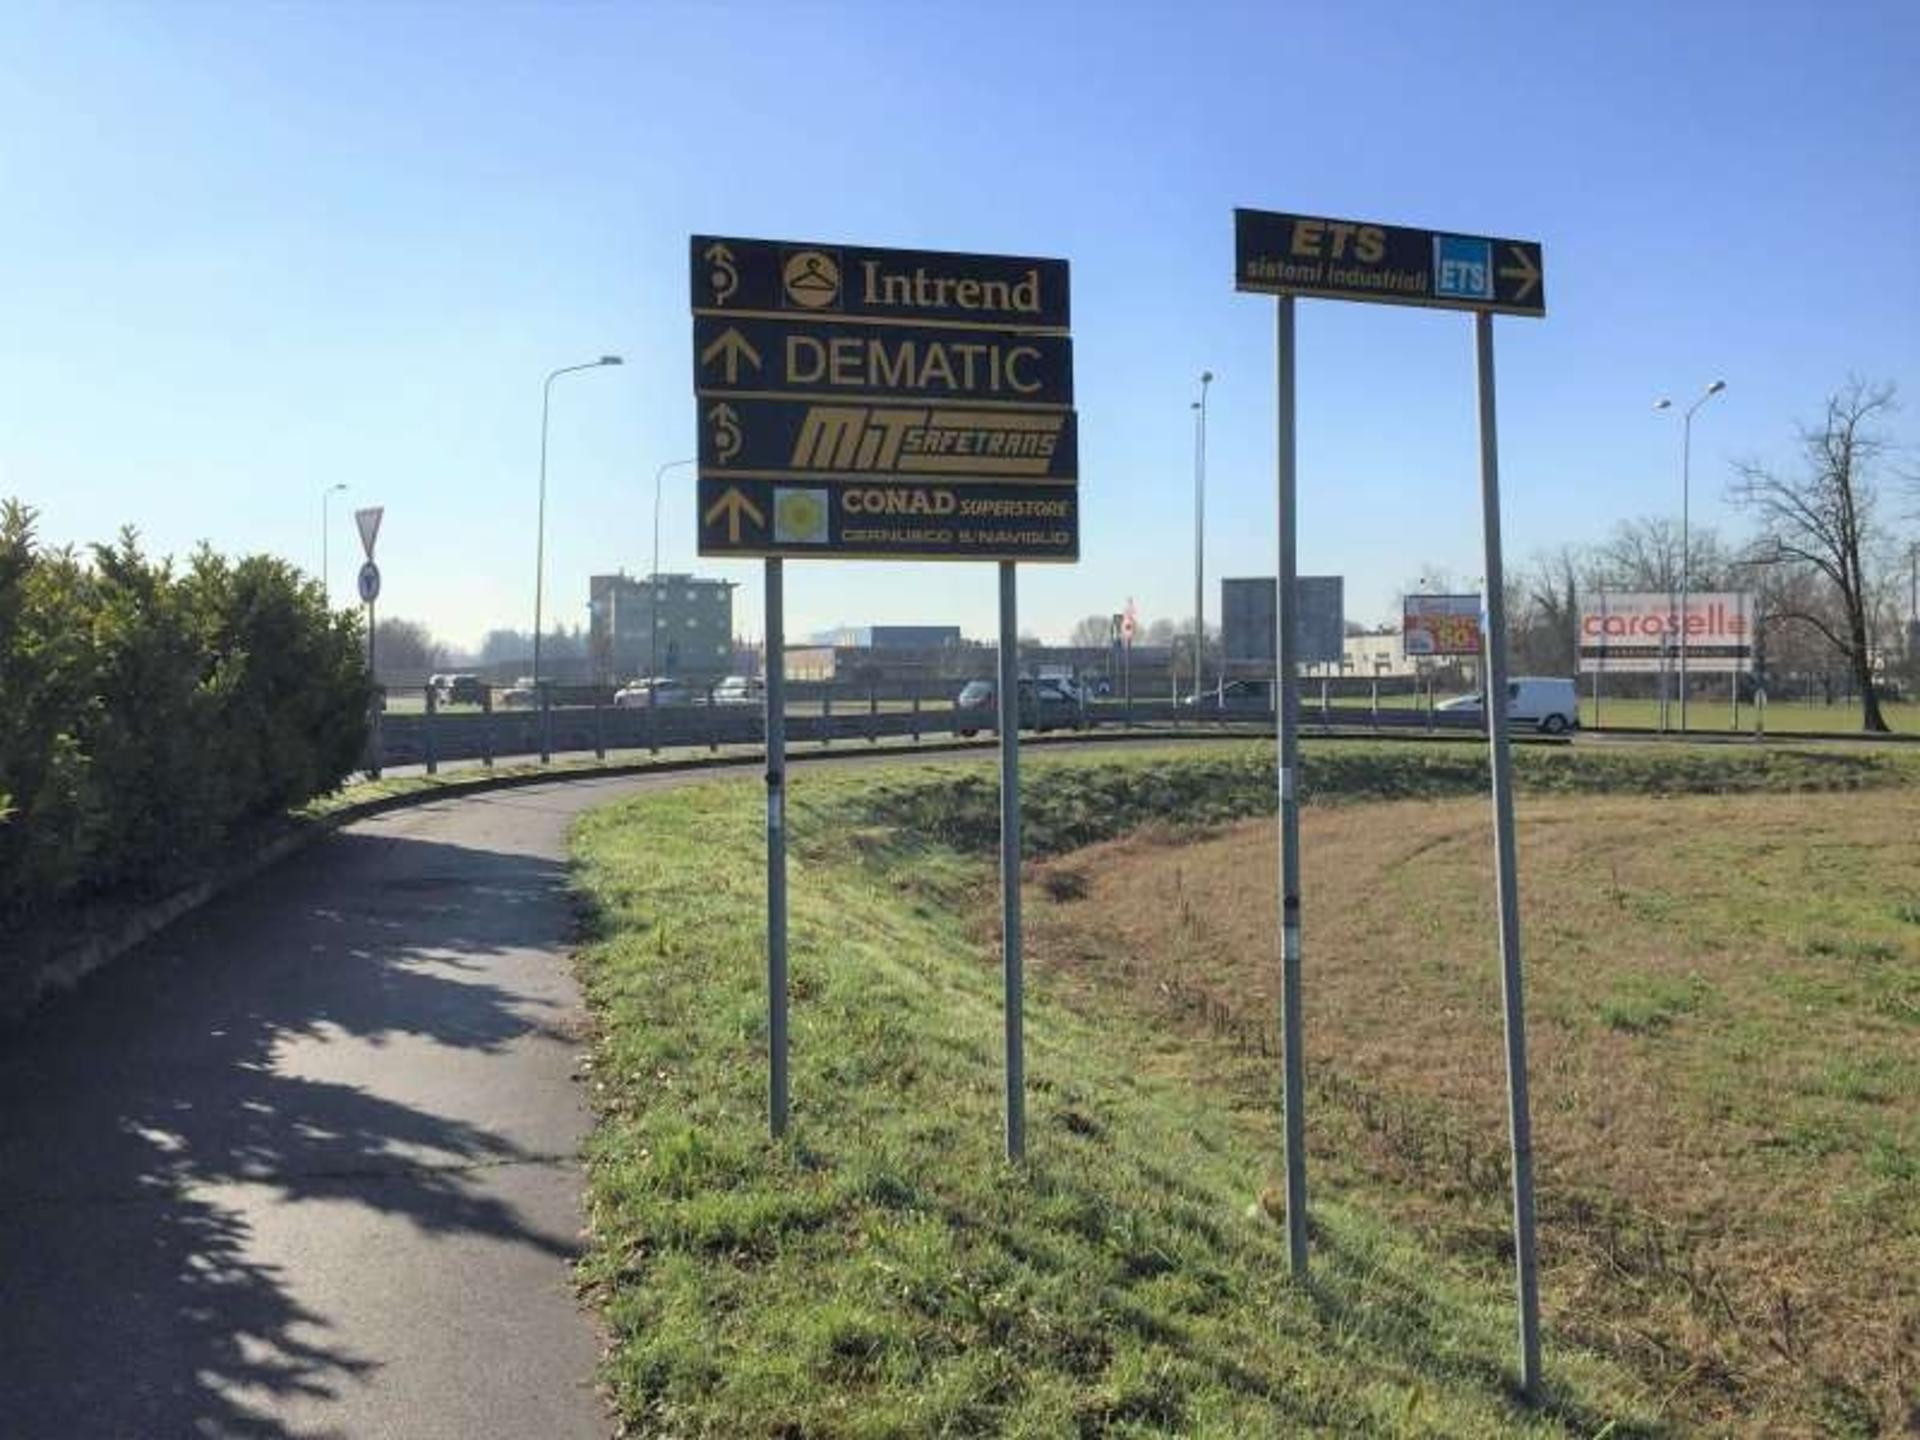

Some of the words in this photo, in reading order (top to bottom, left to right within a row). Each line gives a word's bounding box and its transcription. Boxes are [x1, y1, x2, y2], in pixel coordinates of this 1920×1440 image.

[1292, 220, 1385, 262] ETS
[862, 260, 1042, 313] Intrend
[1247, 256, 1323, 283] sistemi
[1329, 262, 1427, 290] industriali
[1440, 261, 1484, 291] ETS
[786, 335, 1042, 393] DEMATIC
[903, 429, 1057, 456] SAFETRANS
[841, 489, 956, 515] CONAD
[960, 500, 1070, 517] SUPERSTORE
